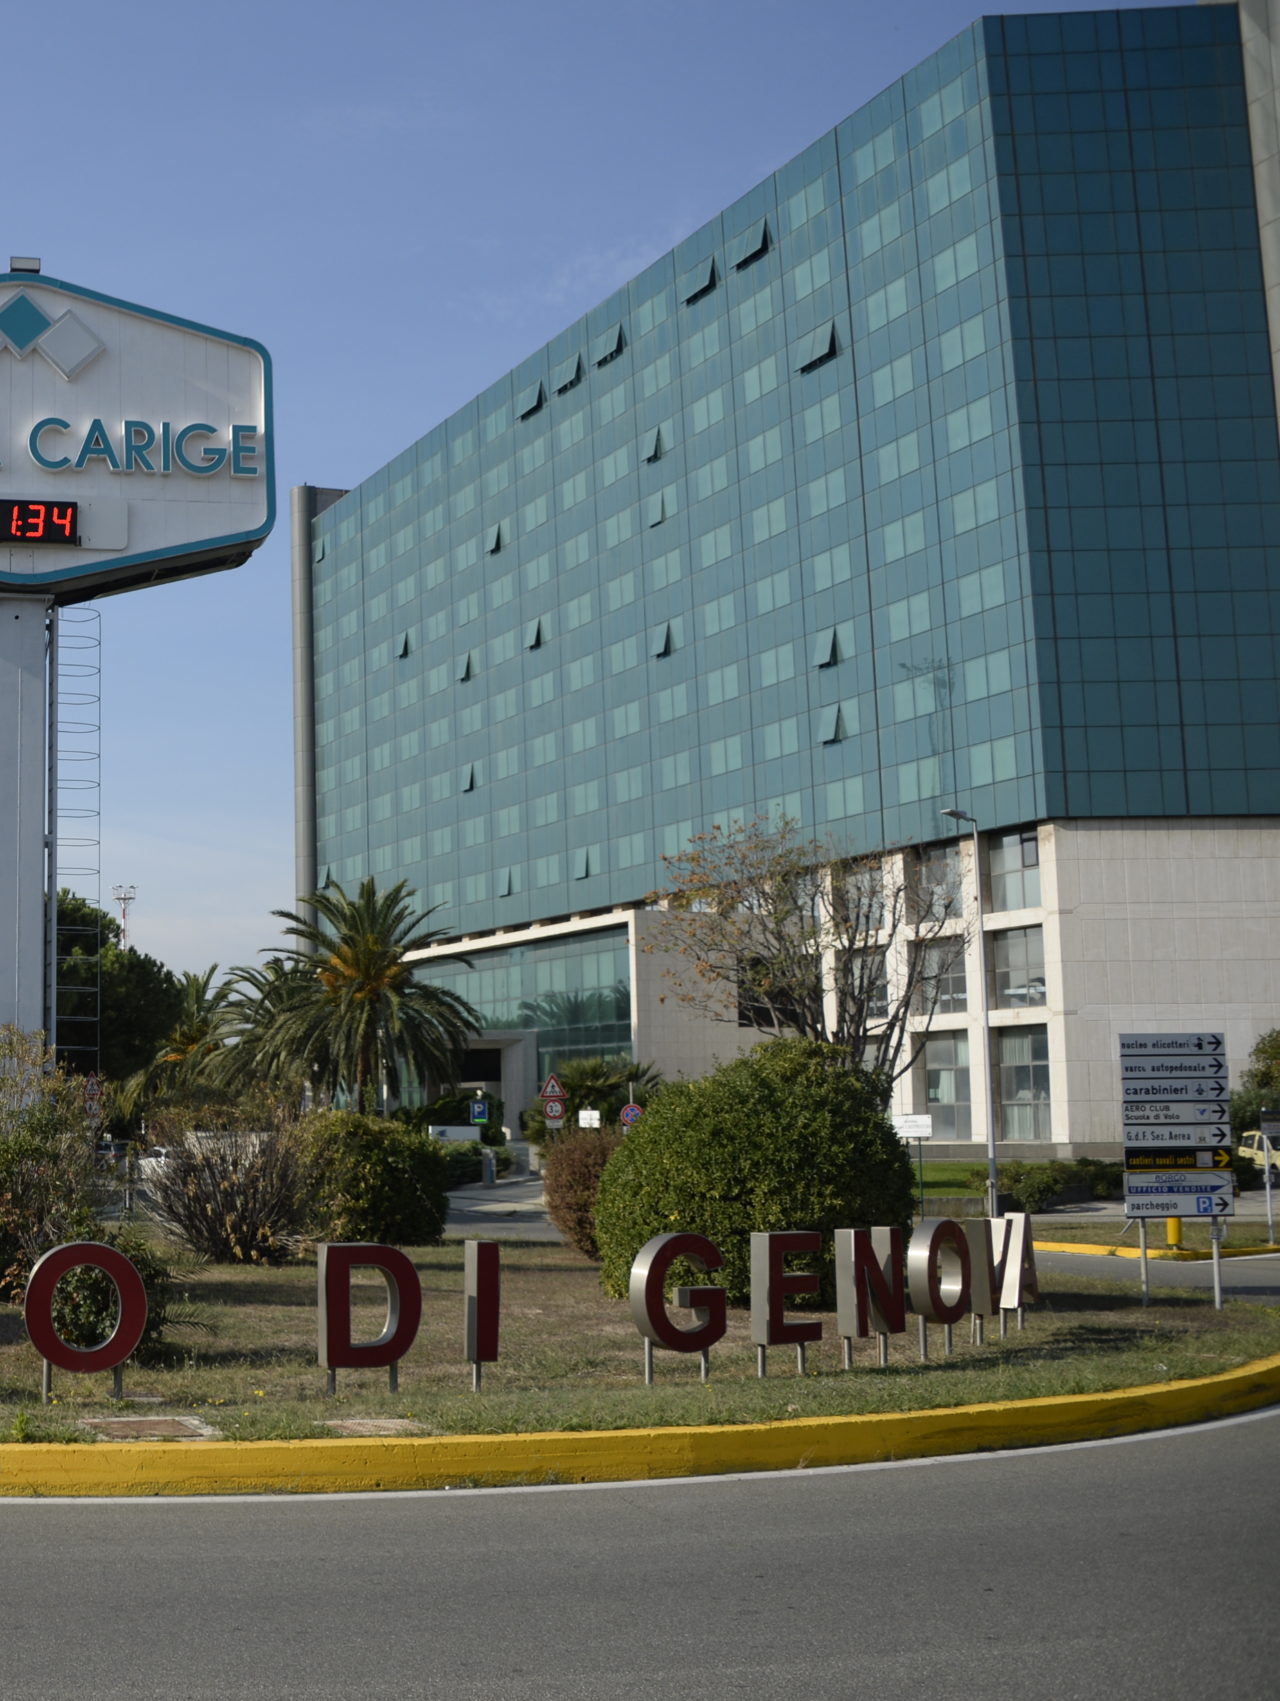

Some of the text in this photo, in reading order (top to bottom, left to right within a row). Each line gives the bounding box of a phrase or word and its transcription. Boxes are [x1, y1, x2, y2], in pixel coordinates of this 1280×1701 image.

[28, 417, 260, 478] CARIGE
[1152, 1039, 1190, 1049] elicotteri
[1151, 1063, 1206, 1074] autopedonale
[1125, 1084, 1188, 1096] carabinieri
[1124, 1113, 1150, 1121] Scuola
[1168, 1131, 1191, 1141] Aerea
[1173, 1185, 1211, 1193] VENDITE
[1131, 1200, 1178, 1212] parcheggio
[318, 1240, 500, 1368] DI
[630, 1212, 1039, 1352] GENOVA
